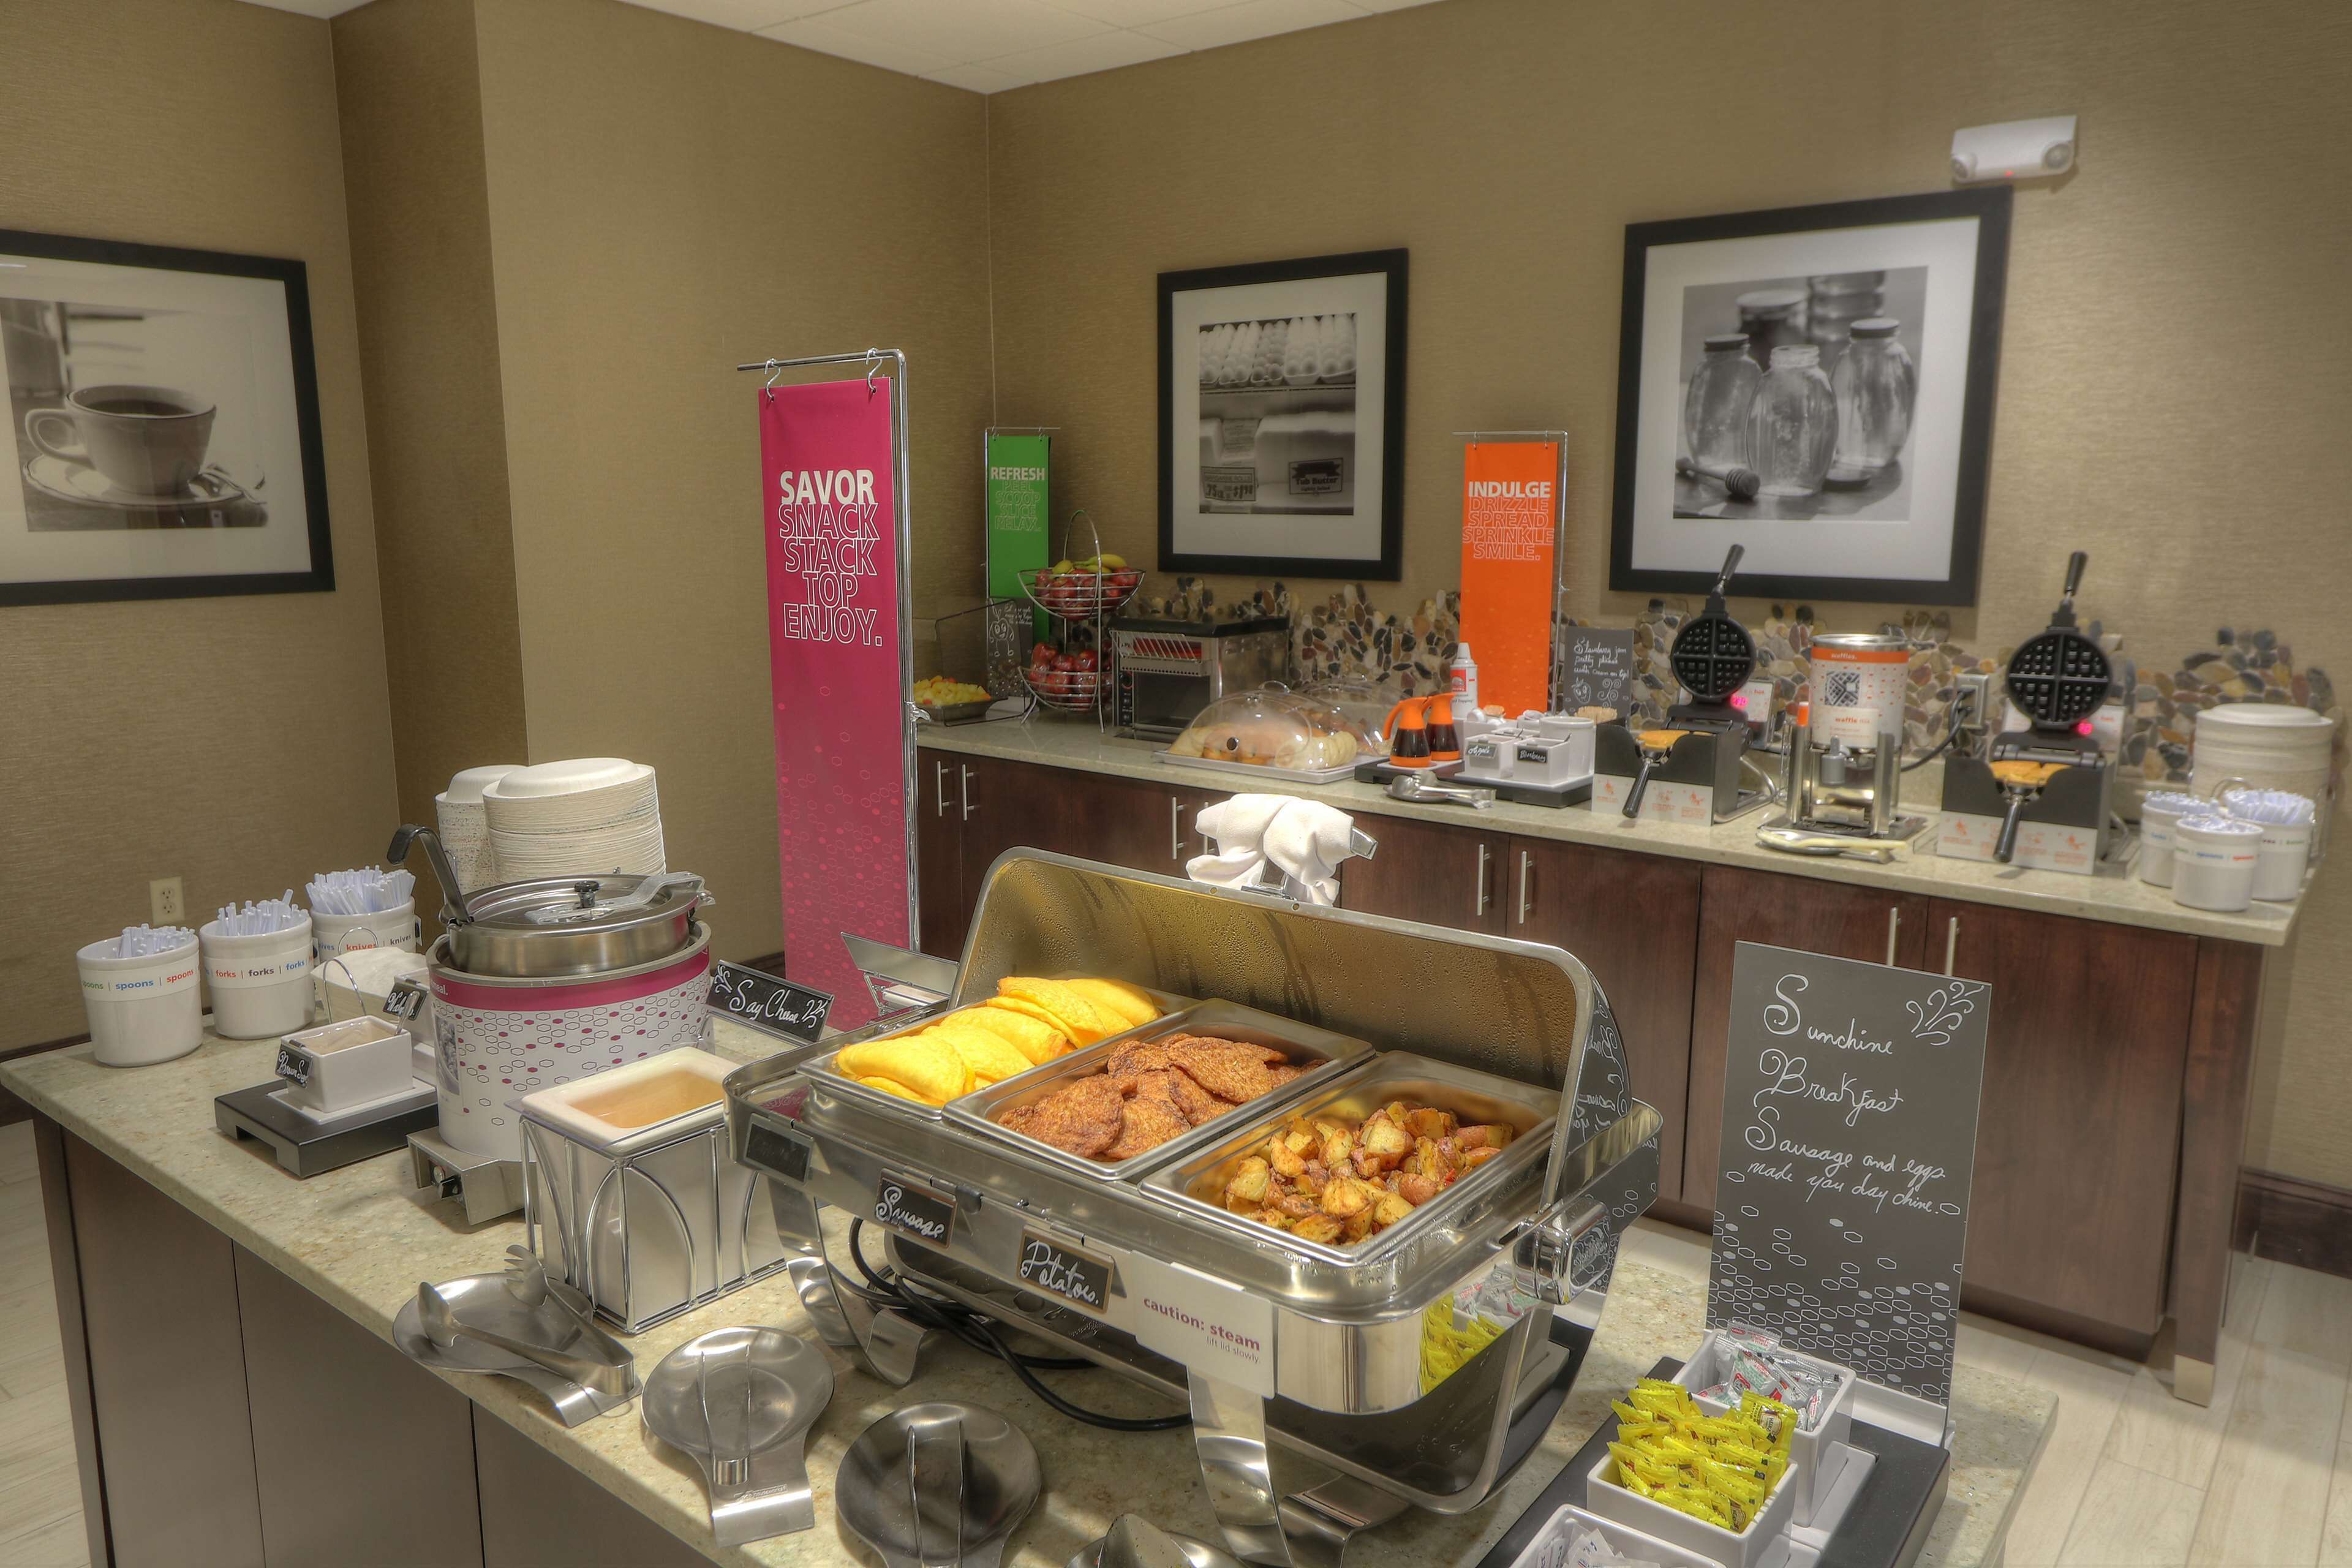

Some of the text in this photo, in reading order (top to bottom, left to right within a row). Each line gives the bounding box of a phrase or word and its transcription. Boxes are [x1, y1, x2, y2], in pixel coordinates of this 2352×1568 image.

[990, 467, 1046, 481] REFRESH
[780, 469, 876, 505] SAVOR
[1002, 480, 1033, 491] PEEL
[1468, 481, 1551, 498] INDULGE
[995, 490, 1041, 505] SCOOP
[1469, 497, 1550, 513] DRIZZLE
[1000, 503, 1036, 517] SLICE
[778, 503, 881, 540] SNACK
[1468, 511, 1549, 529] SPREAD
[1462, 527, 1555, 545] SPRINKLE
[783, 537, 878, 576] STACK
[1473, 542, 1541, 561] SMILE.
[802, 570, 859, 608] TOP
[783, 603, 883, 647] ENJOY.
[318, 942, 335, 951] nives
[390, 933, 412, 946] knives
[215, 970, 237, 978] forks
[248, 968, 275, 978] forks
[285, 959, 306, 971] forks
[115, 979, 154, 991] spoons
[166, 968, 194, 984] spoons
[729, 979, 764, 1021] Say
[1745, 1106, 1853, 1177] Sausage
[1862, 1154, 1897, 1172] and
[1746, 1161, 1794, 1183] made
[1806, 1174, 1845, 1203] you
[1851, 1172, 1890, 1214] day
[1143, 1297, 1261, 1351] caution: steam
[1207, 1335, 1218, 1348] lift
[1220, 1341, 1231, 1352] lid
